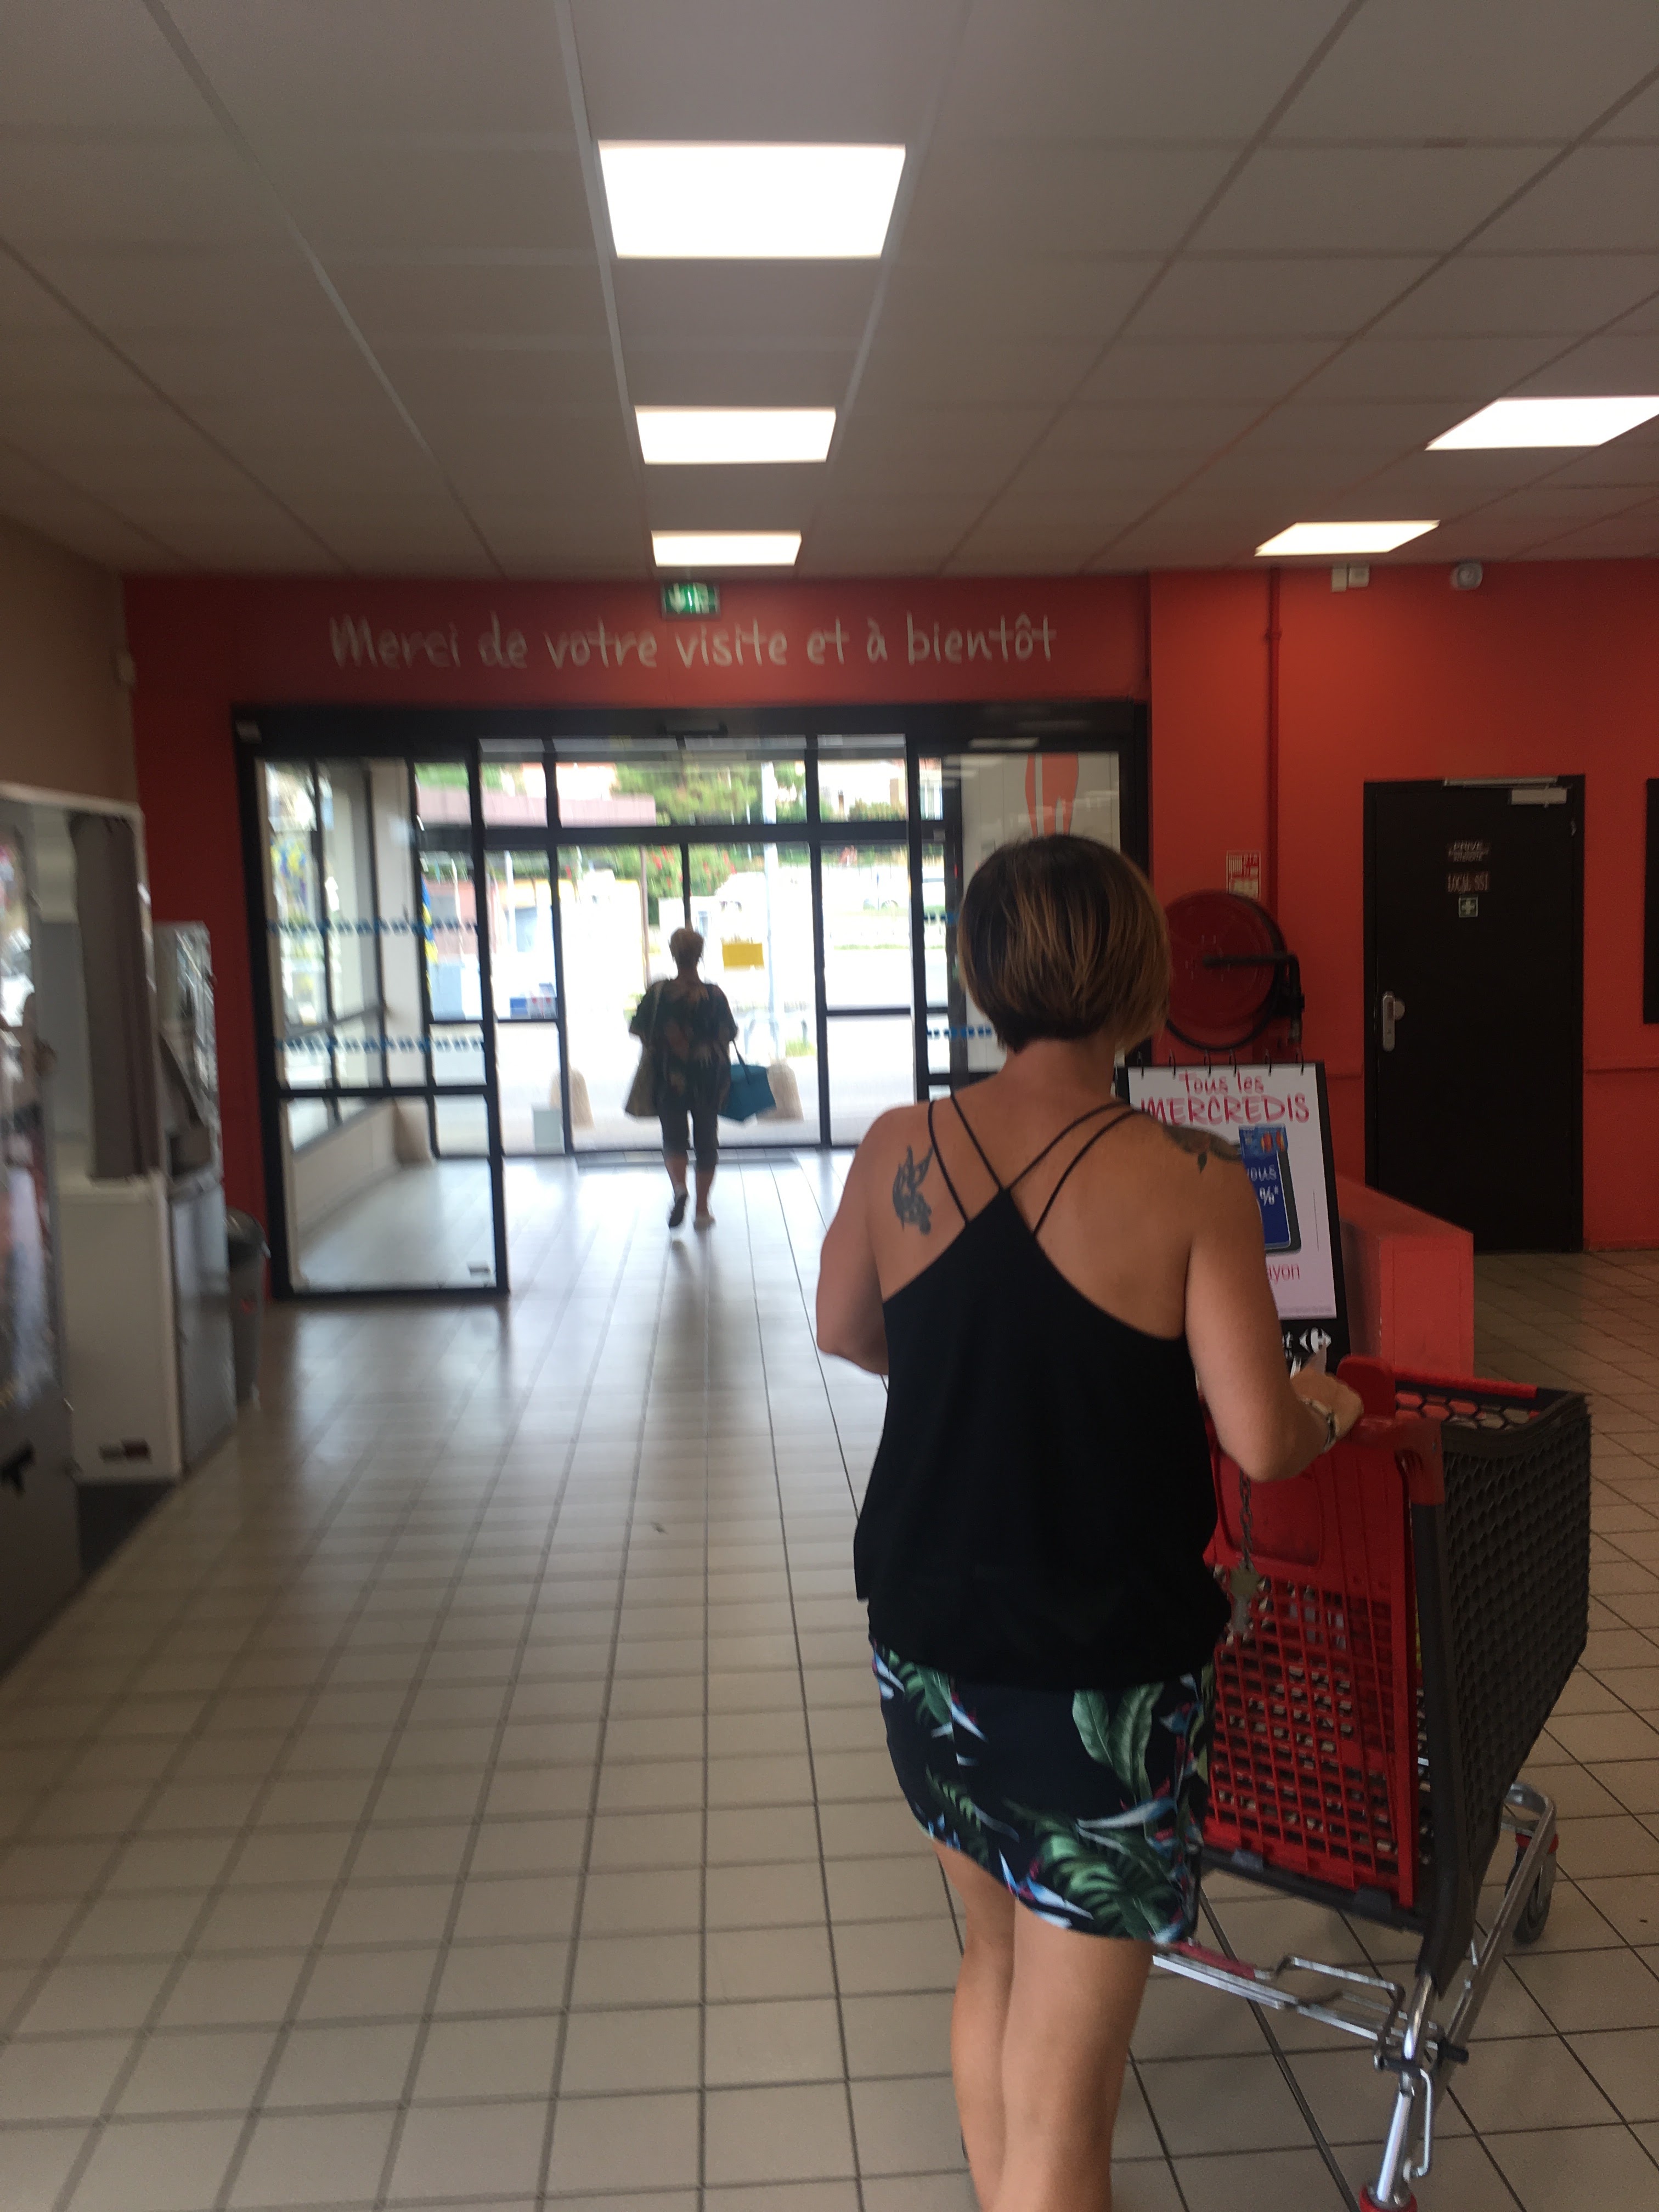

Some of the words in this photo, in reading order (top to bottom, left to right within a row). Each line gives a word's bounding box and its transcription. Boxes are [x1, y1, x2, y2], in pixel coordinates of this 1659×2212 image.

[330, 614, 461, 668] Merci
[477, 611, 528, 669] de
[544, 615, 658, 668] votre
[675, 618, 787, 668] visite
[806, 616, 849, 665] et
[867, 617, 888, 664] à
[906, 610, 1057, 666] bientôt
[1179, 1070, 1228, 1095] Tous
[1237, 1069, 1264, 1093] les
[1141, 1092, 1310, 1125] MERCREDIS
